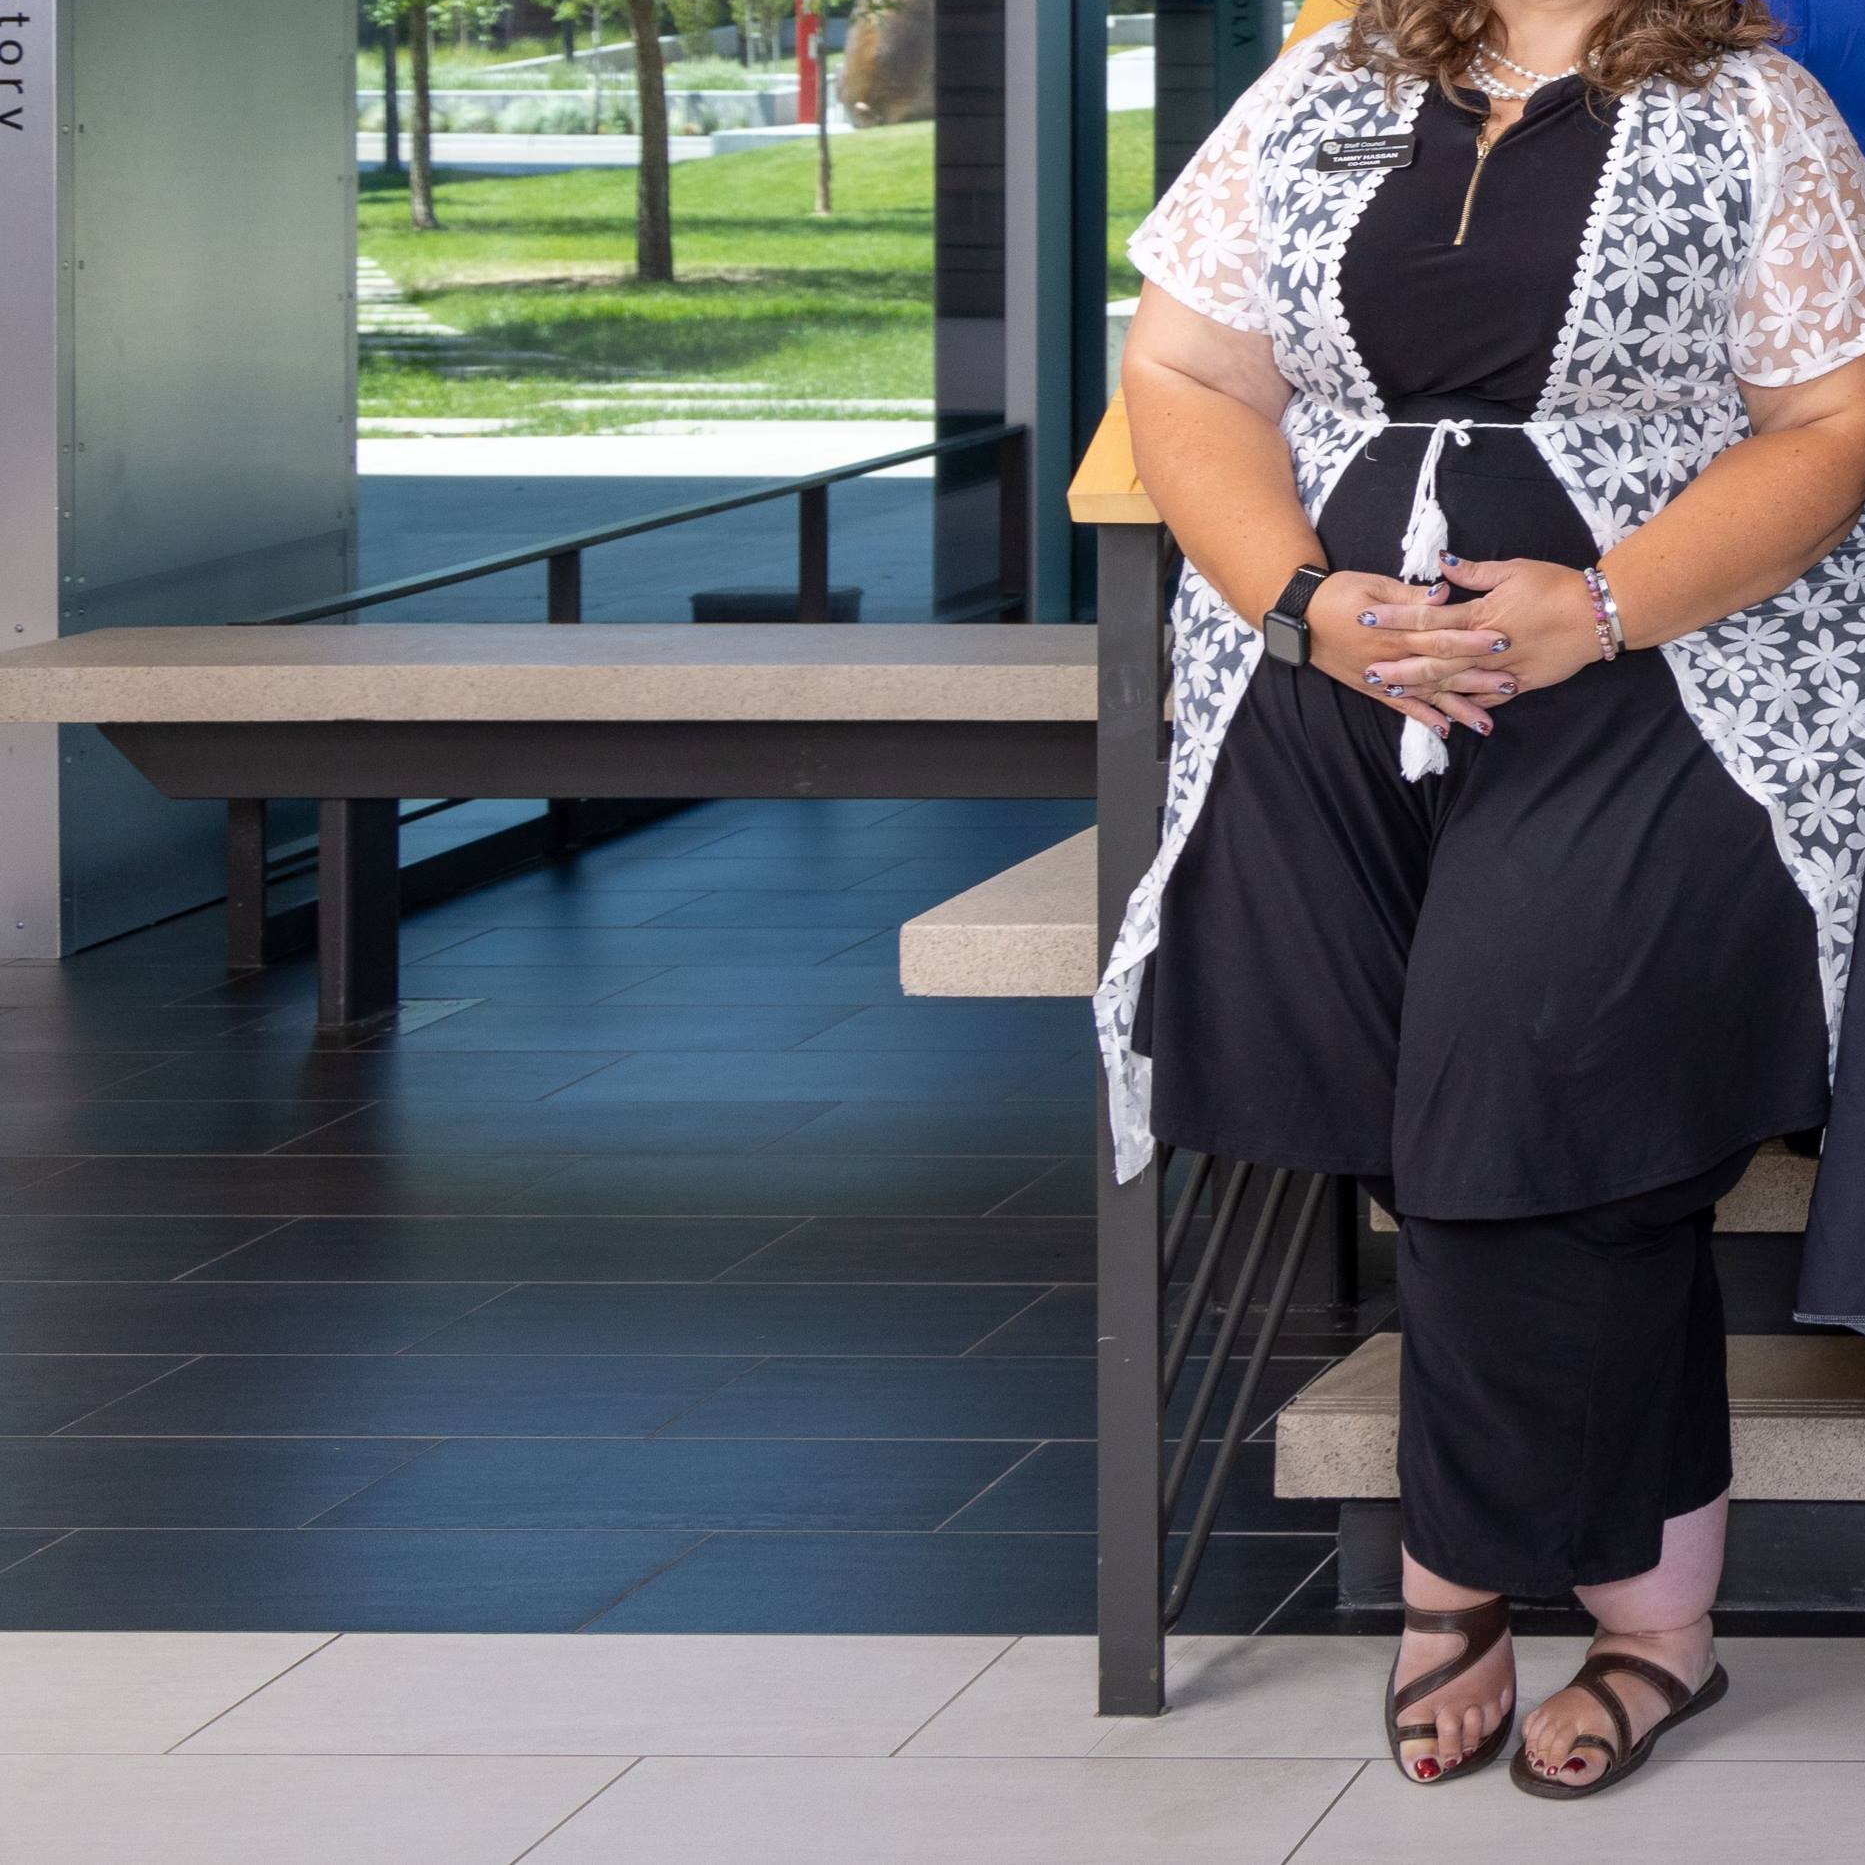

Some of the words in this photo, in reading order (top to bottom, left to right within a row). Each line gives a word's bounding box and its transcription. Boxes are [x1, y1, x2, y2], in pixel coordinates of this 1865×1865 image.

[1322, 141, 1342, 154] CU
[1361, 140, 1386, 148] Council
[1333, 154, 1362, 162] TAMMY
[1362, 152, 1399, 160] HASSAN
